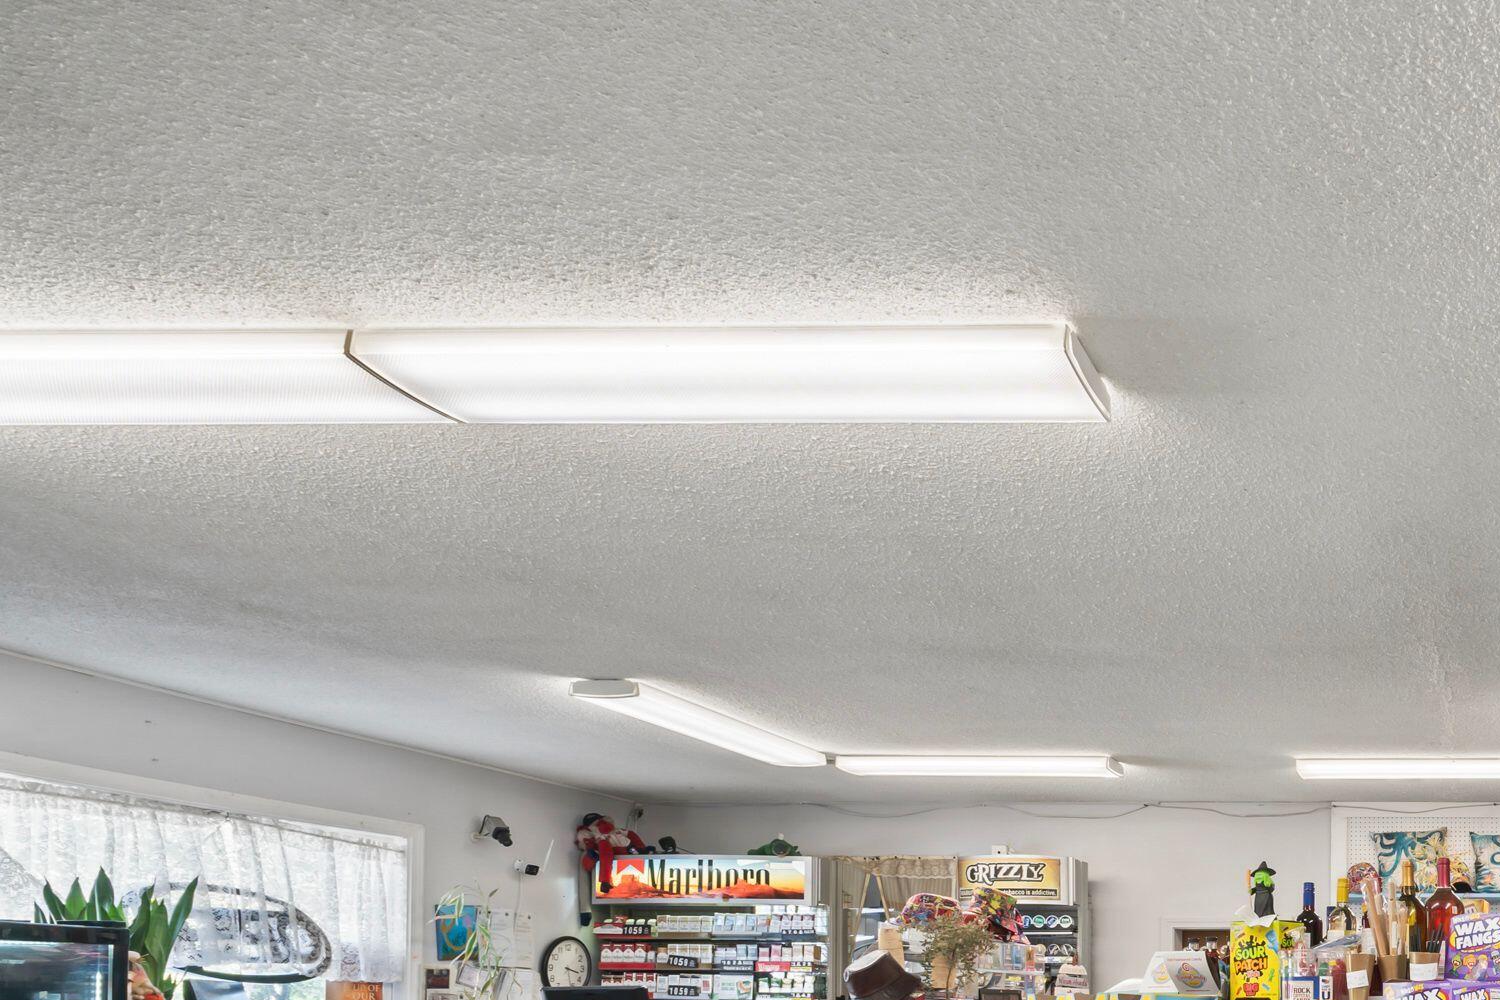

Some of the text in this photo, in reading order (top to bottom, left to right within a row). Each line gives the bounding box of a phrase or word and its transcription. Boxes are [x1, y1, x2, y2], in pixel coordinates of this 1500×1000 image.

[649, 858, 770, 895] Marlboro
[966, 862, 1046, 886] GRIZZLY
[1031, 889, 1057, 897] addictive.
[623, 926, 642, 935] 1059
[1455, 916, 1500, 937] WAX
[1235, 945, 1267, 961] SOUR
[668, 956, 689, 967] 1059
[1234, 957, 1268, 973] PATCH
[368, 984, 381, 992] OF
[668, 986, 689, 996] 1059
[352, 991, 376, 1000] OUR
